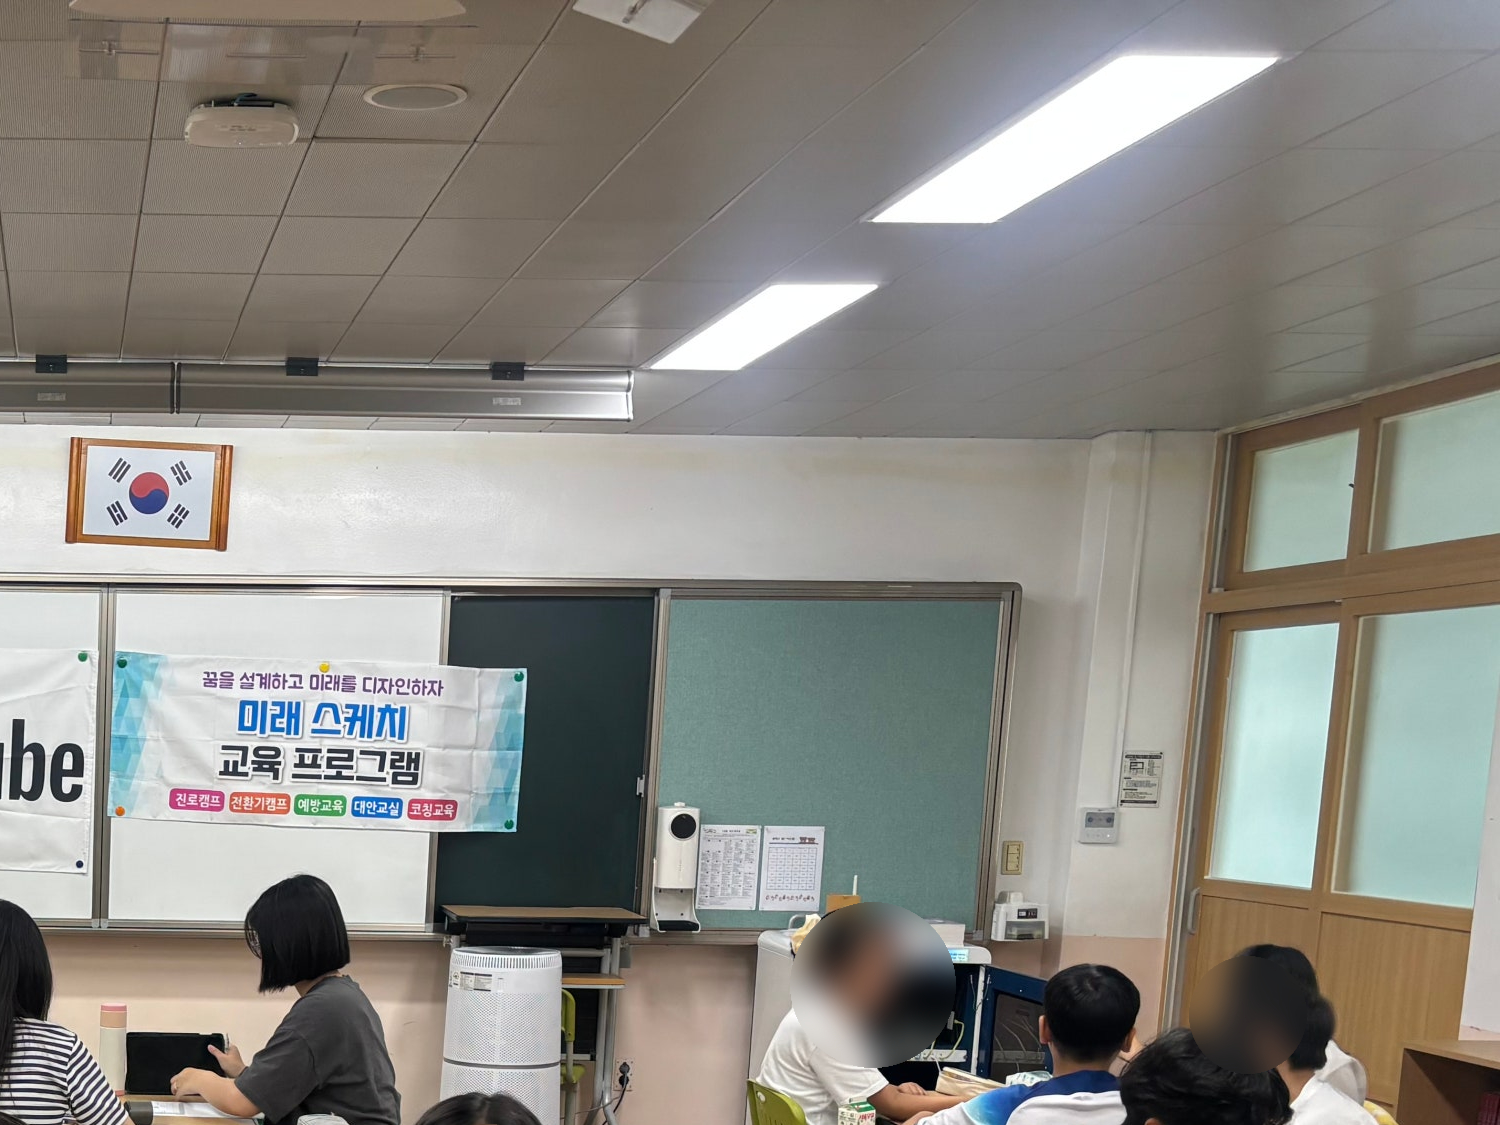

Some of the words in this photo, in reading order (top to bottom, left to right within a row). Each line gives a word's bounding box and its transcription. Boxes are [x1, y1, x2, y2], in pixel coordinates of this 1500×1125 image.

[202, 671, 235, 688] 꿈을
[239, 672, 304, 691] 설계하고
[309, 674, 357, 695] 미래를
[362, 677, 444, 697] 디자인하자
[238, 700, 301, 737] 미래
[311, 701, 407, 741] 스케치
[218, 744, 282, 781] 교육
[291, 746, 422, 787] 프로그램
[175, 792, 221, 808] 진로캠프
[230, 795, 289, 812] 전환기캠프
[297, 798, 344, 815] 예방교육
[354, 799, 400, 817] 대안교실
[408, 801, 455, 818] 코칭교육
